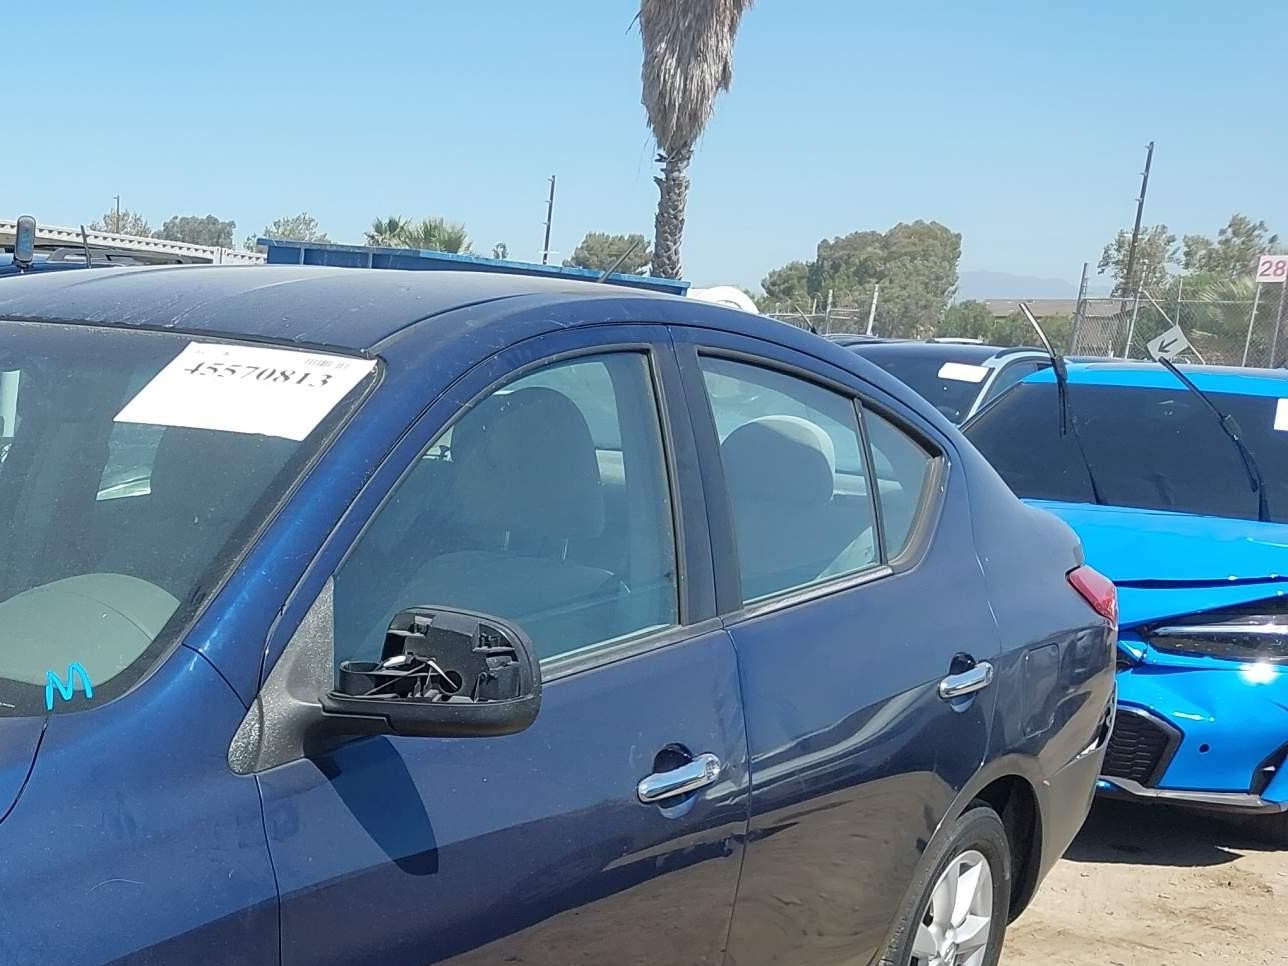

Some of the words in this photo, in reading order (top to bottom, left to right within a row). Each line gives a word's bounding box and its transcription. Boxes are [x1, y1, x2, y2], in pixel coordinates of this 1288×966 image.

[1259, 260, 1287, 277] 28
[184, 361, 334, 388] 45570813
[45, 662, 93, 710] M
